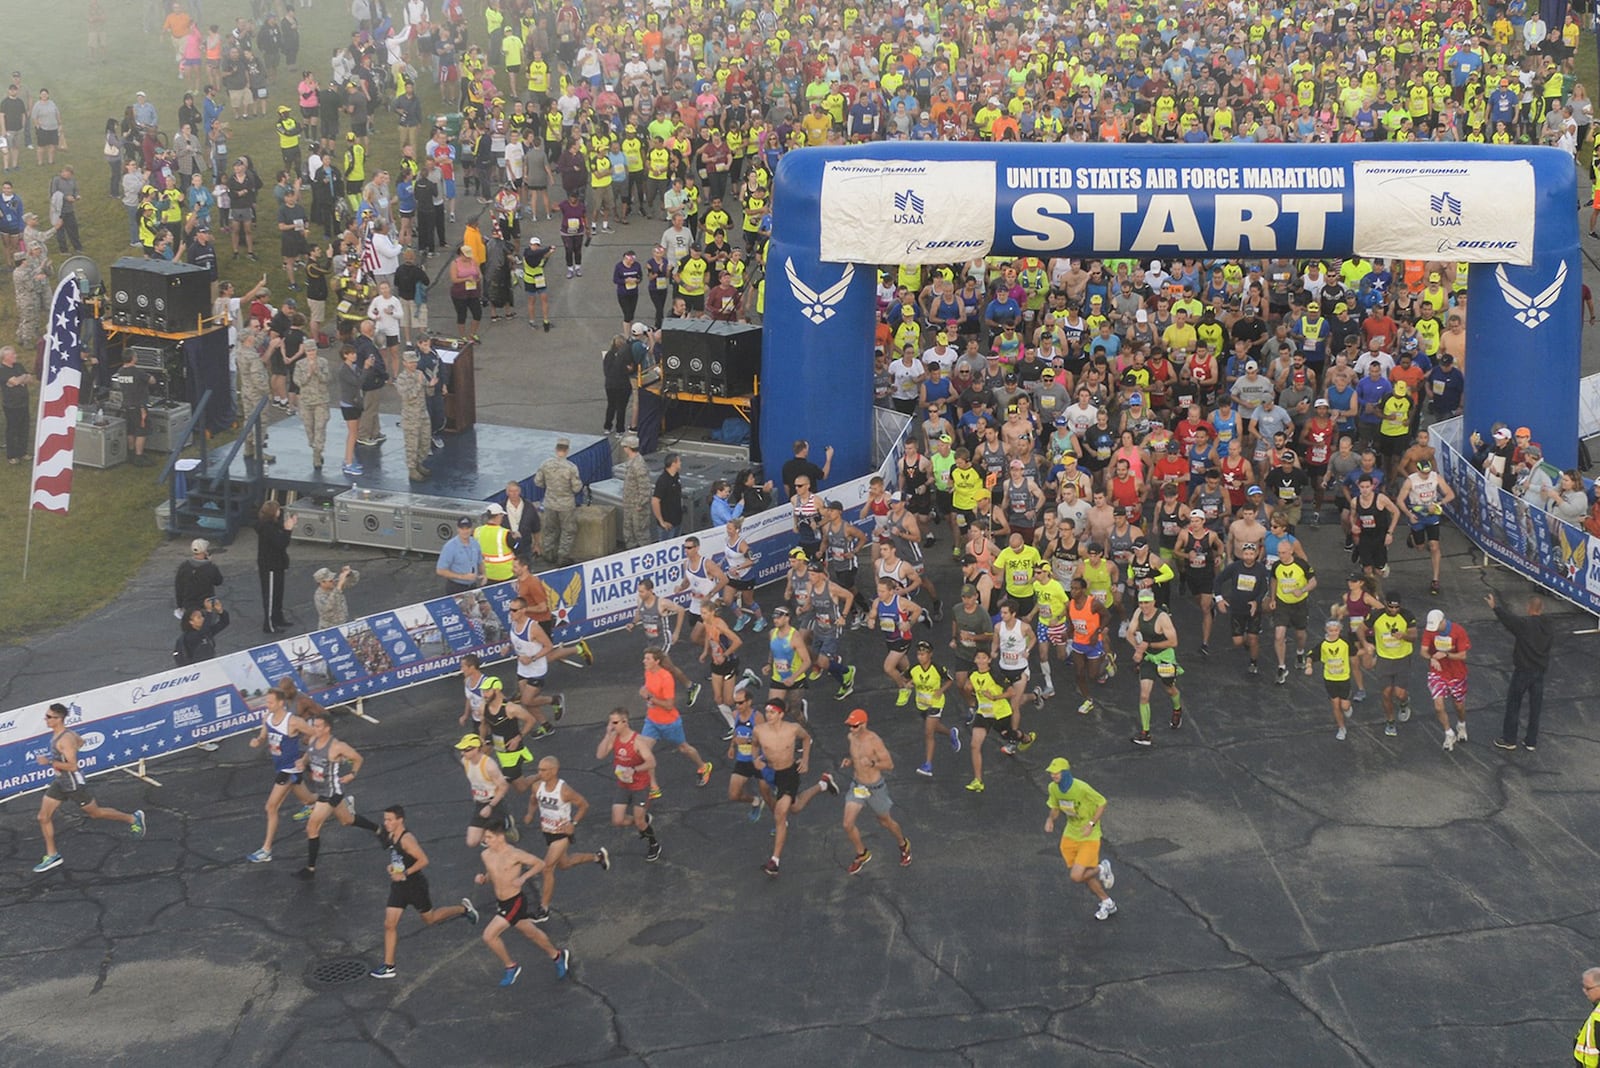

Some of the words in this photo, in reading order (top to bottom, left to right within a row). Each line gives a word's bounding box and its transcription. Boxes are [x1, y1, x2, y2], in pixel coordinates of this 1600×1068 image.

[831, 165, 881, 174] NORTHROP
[1006, 167, 1072, 189] UNITED
[1076, 167, 1143, 190] STATES
[1145, 167, 1178, 189] AIR
[1181, 167, 1240, 190] FORCE
[1242, 167, 1346, 189] MARATHON
[893, 213, 924, 225] USAA
[1011, 193, 1344, 252] START
[1430, 216, 1462, 227] USAA
[925, 240, 985, 249] BOEING
[1456, 240, 1518, 249] BOEING
[591, 561, 625, 586] AIR
[150, 672, 201, 693] BOEING
